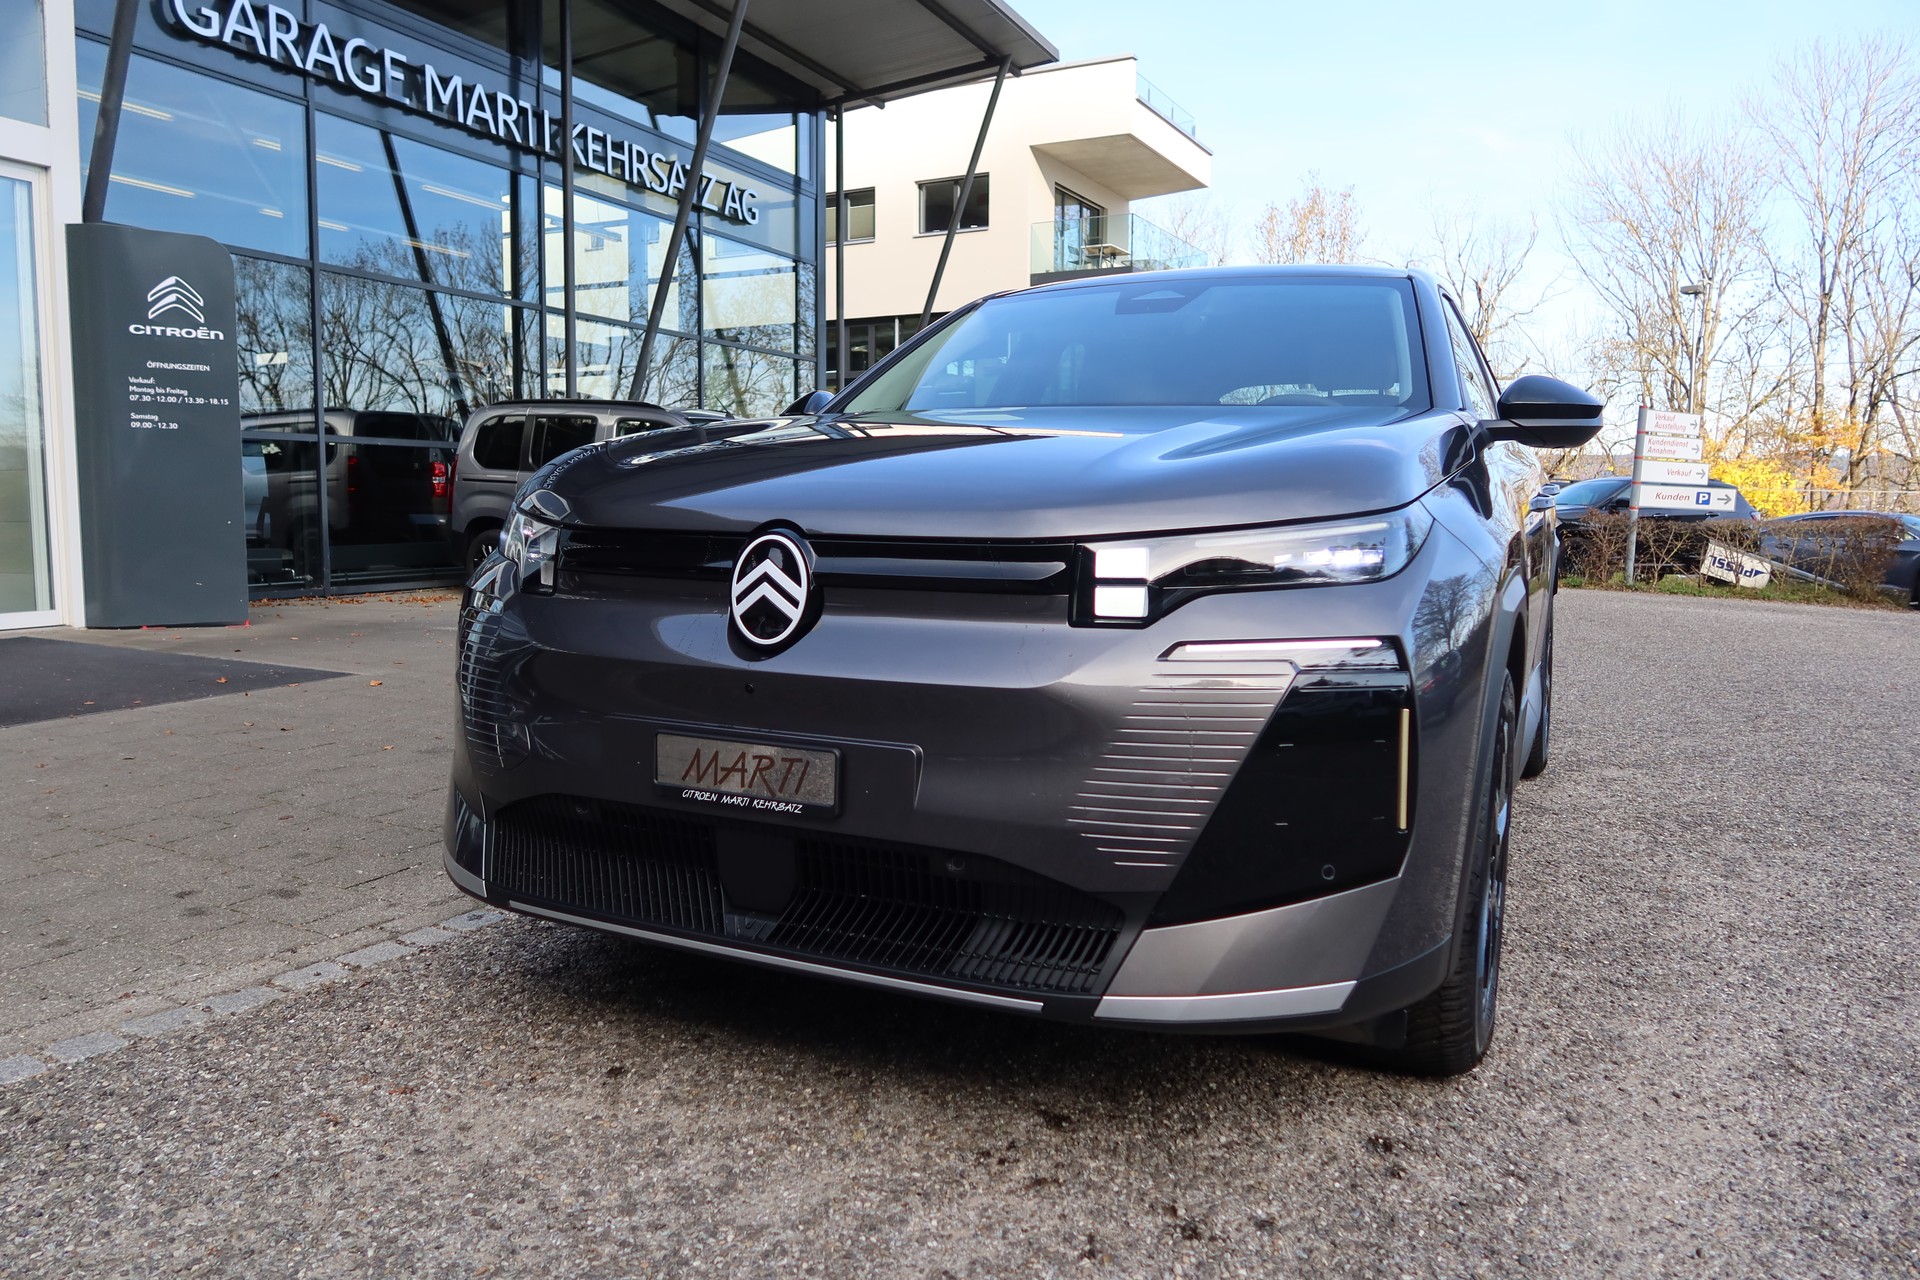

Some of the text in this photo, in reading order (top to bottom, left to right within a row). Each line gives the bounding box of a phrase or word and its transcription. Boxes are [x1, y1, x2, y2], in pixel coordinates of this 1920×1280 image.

[172, 0, 759, 225] GARAGE MARTI KEHRSAZ AG
[146, 360, 211, 372] ÖFFNUNGSZEITEN
[128, 376, 156, 385] Verkauf:
[128, 385, 155, 395] Montag
[166, 387, 188, 396] Freitag
[129, 394, 151, 402] 07.30
[156, 395, 177, 403] 12.00
[184, 396, 205, 404] 13.30
[209, 398, 230, 406] 18.15
[130, 412, 158, 421] Samstag
[1655, 412, 1676, 421] Verkauf
[130, 421, 153, 429] 09.00
[158, 422, 179, 430] 12.30
[1654, 421, 1687, 432] Ausstellung
[1647, 438, 1689, 447] Kundendienst
[1647, 448, 1677, 456] Annahme
[1666, 467, 1693, 478] Verkauf
[1655, 491, 1690, 502] Kunden
[681, 748, 810, 797] MARTI
[682, 789, 719, 802] CITROEN
[720, 795, 750, 807] MARTI
